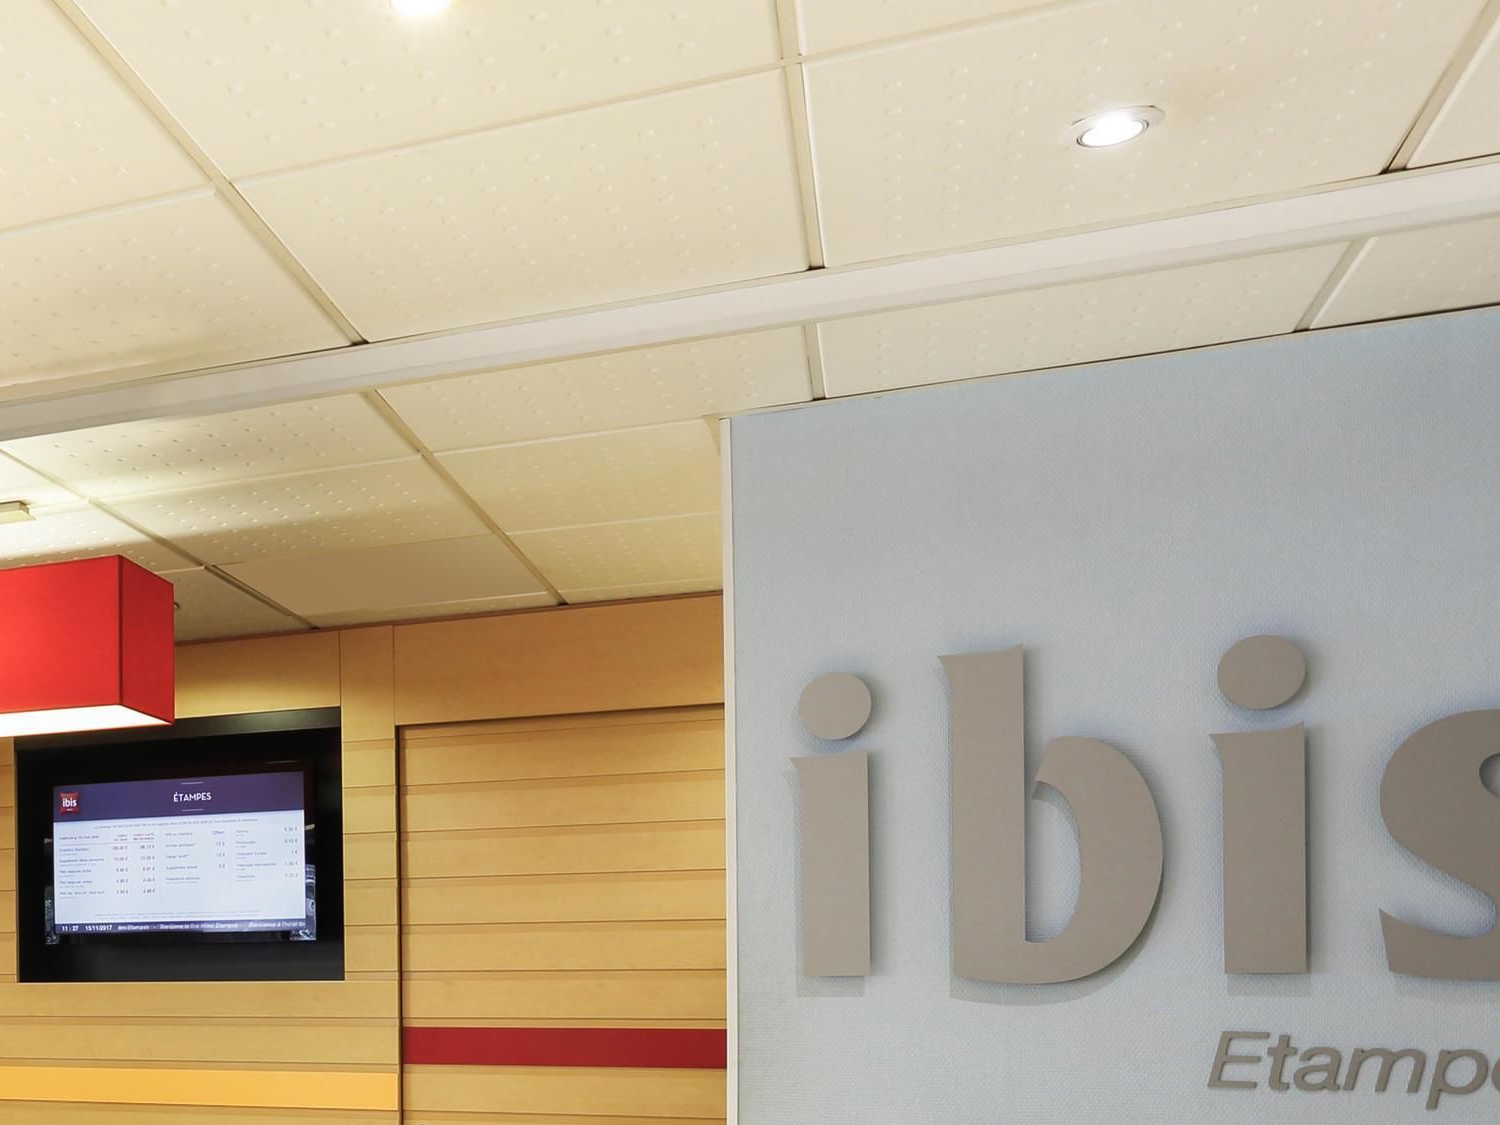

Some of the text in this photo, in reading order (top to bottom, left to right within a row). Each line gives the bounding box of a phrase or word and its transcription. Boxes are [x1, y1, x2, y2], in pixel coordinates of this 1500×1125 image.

[62, 798, 77, 807] ibis
[173, 792, 212, 802] ÉTAMPES
[789, 634, 1500, 985] ibis
[1208, 1031, 1500, 1110] Etamp
